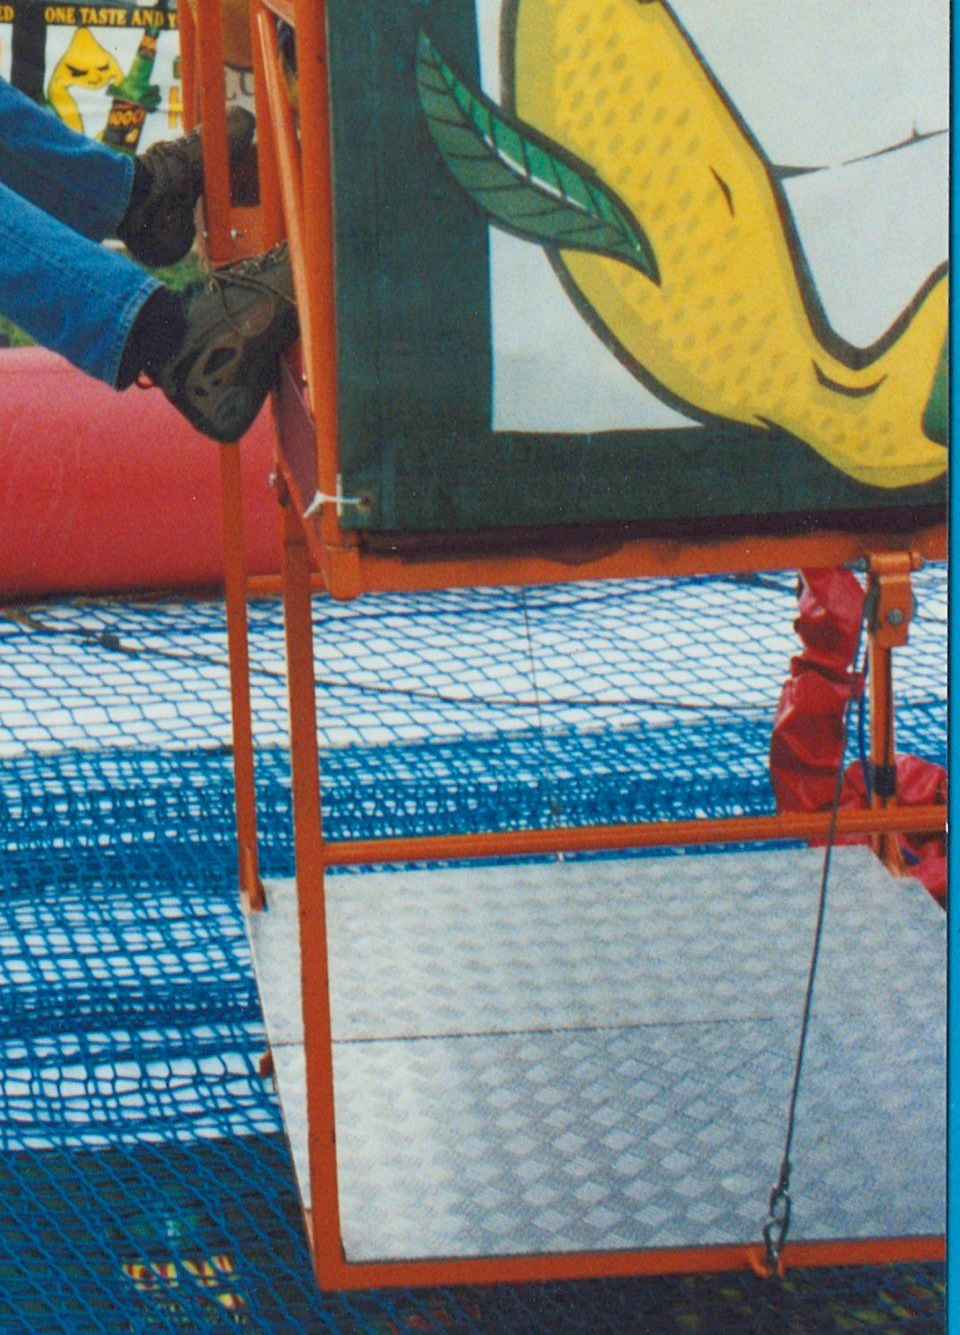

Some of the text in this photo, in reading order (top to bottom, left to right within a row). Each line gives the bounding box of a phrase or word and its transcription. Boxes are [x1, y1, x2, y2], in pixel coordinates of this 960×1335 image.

[44, 7, 76, 24] ONE
[80, 8, 128, 26] TASTE
[131, 9, 164, 27] AND
